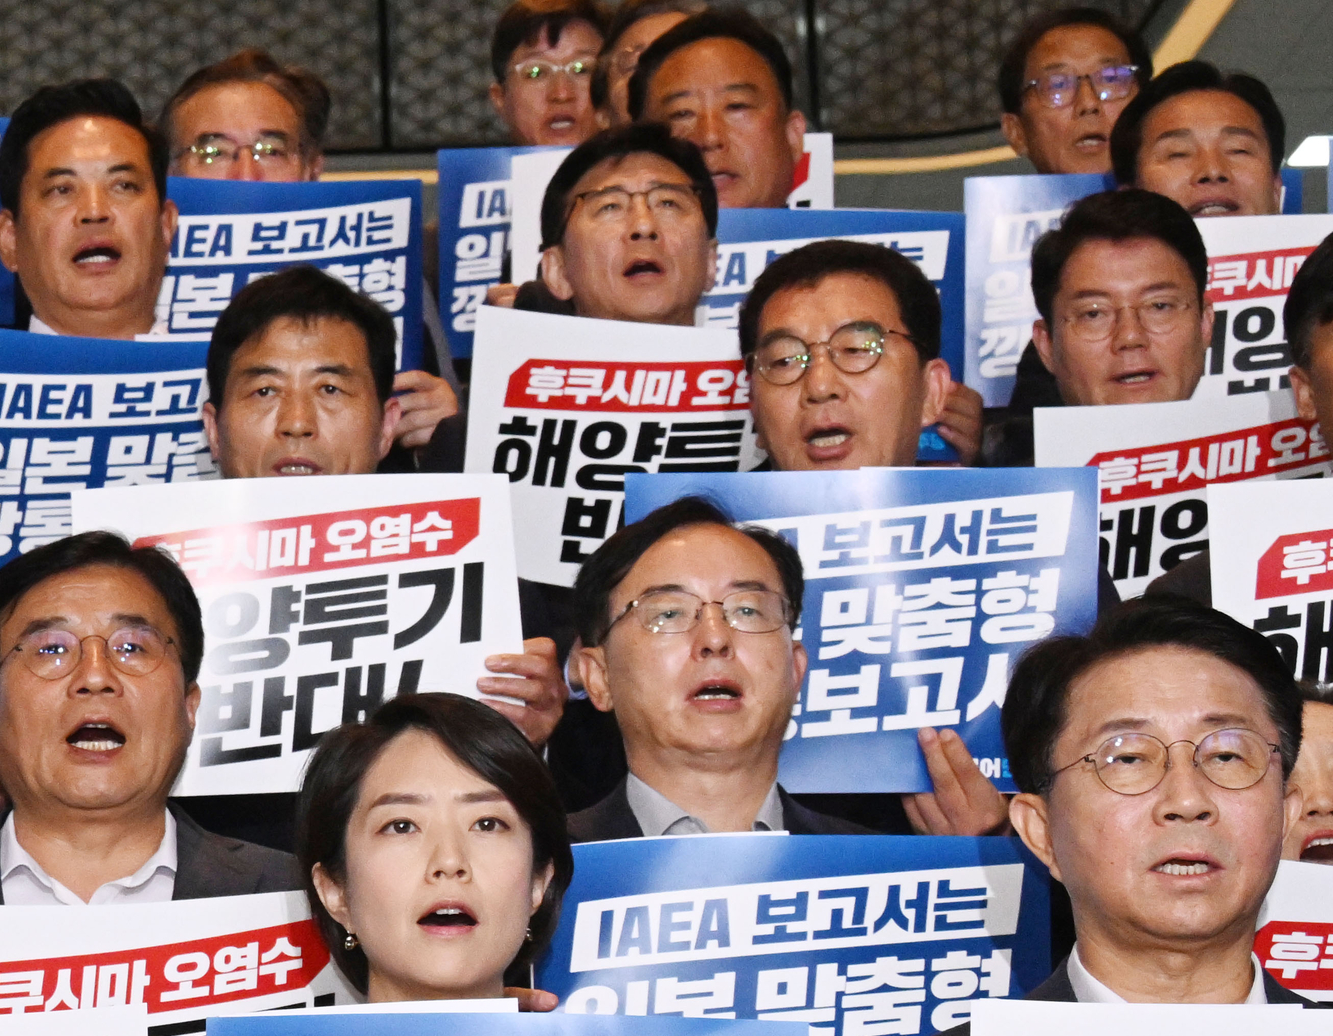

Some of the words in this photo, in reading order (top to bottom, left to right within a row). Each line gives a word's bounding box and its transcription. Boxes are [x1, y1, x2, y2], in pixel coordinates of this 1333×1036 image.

[246, 210, 394, 256] 보고서는
[108, 378, 202, 419] 보고
[524, 365, 687, 407] 후쿠시마
[1099, 434, 1262, 495] 후쿠시마
[322, 510, 454, 562] 오염수
[818, 506, 1038, 570] 보고서는
[206, 561, 485, 677] 양투기
[818, 567, 1061, 661] 맞춤형
[597, 897, 731, 960] IAEA
[751, 878, 987, 947] 보고서는
[159, 936, 303, 1004] 오염수
